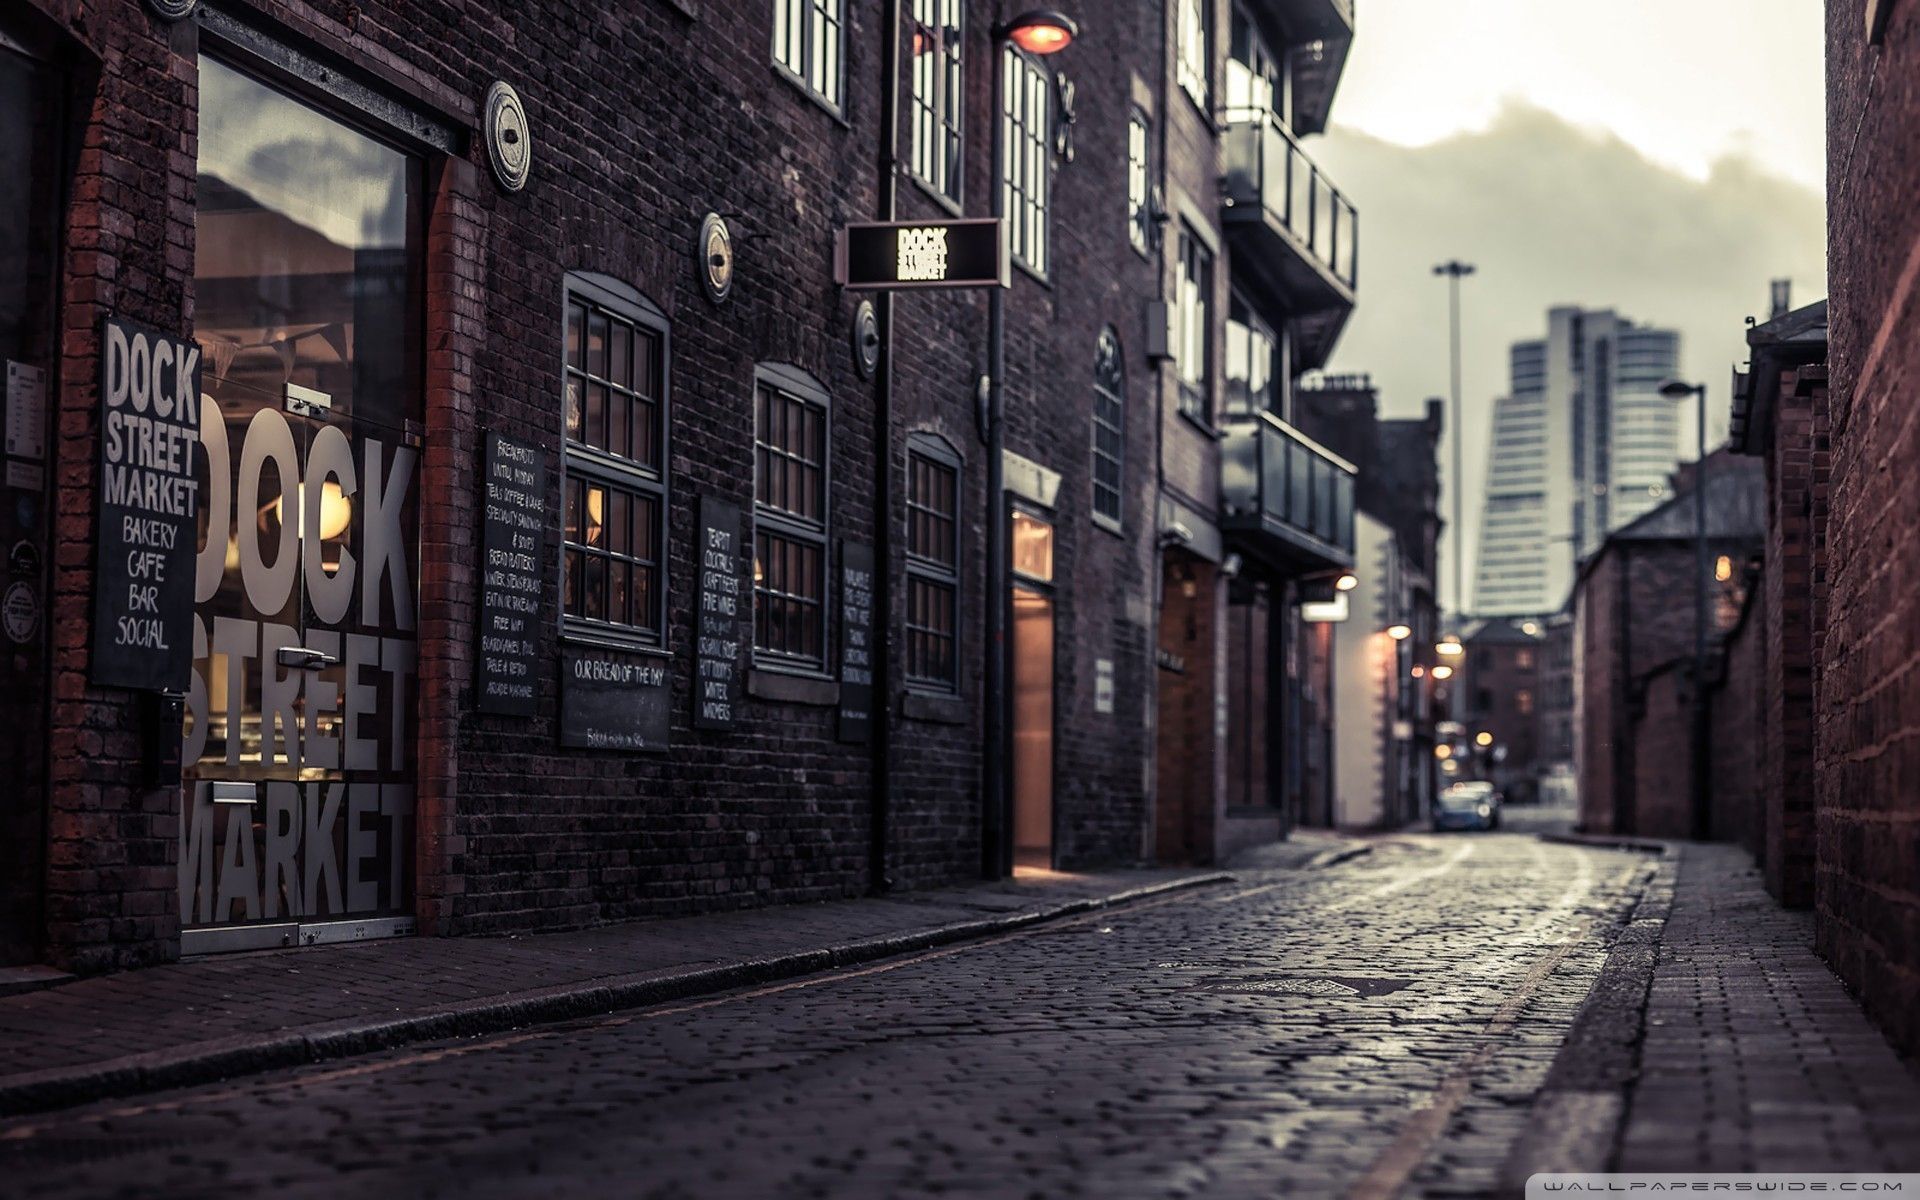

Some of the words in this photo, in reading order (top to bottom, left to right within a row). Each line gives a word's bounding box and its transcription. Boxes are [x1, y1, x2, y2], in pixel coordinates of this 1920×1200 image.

[898, 228, 948, 250] DOCK
[107, 323, 199, 425] DOCK
[106, 410, 198, 477] STREET
[104, 463, 198, 517] MARKET
[123, 515, 178, 550] BAKERY
[127, 550, 166, 582] CAFE
[129, 583, 159, 613] BAR
[115, 615, 169, 650] SOCIAL
[493, 615, 509, 630] FREE
[575, 659, 592, 680] OUR
[593, 660, 620, 681] BREAD
[621, 664, 633, 683] OF
[634, 665, 650, 684] THE
[650, 668, 664, 686] DAY
